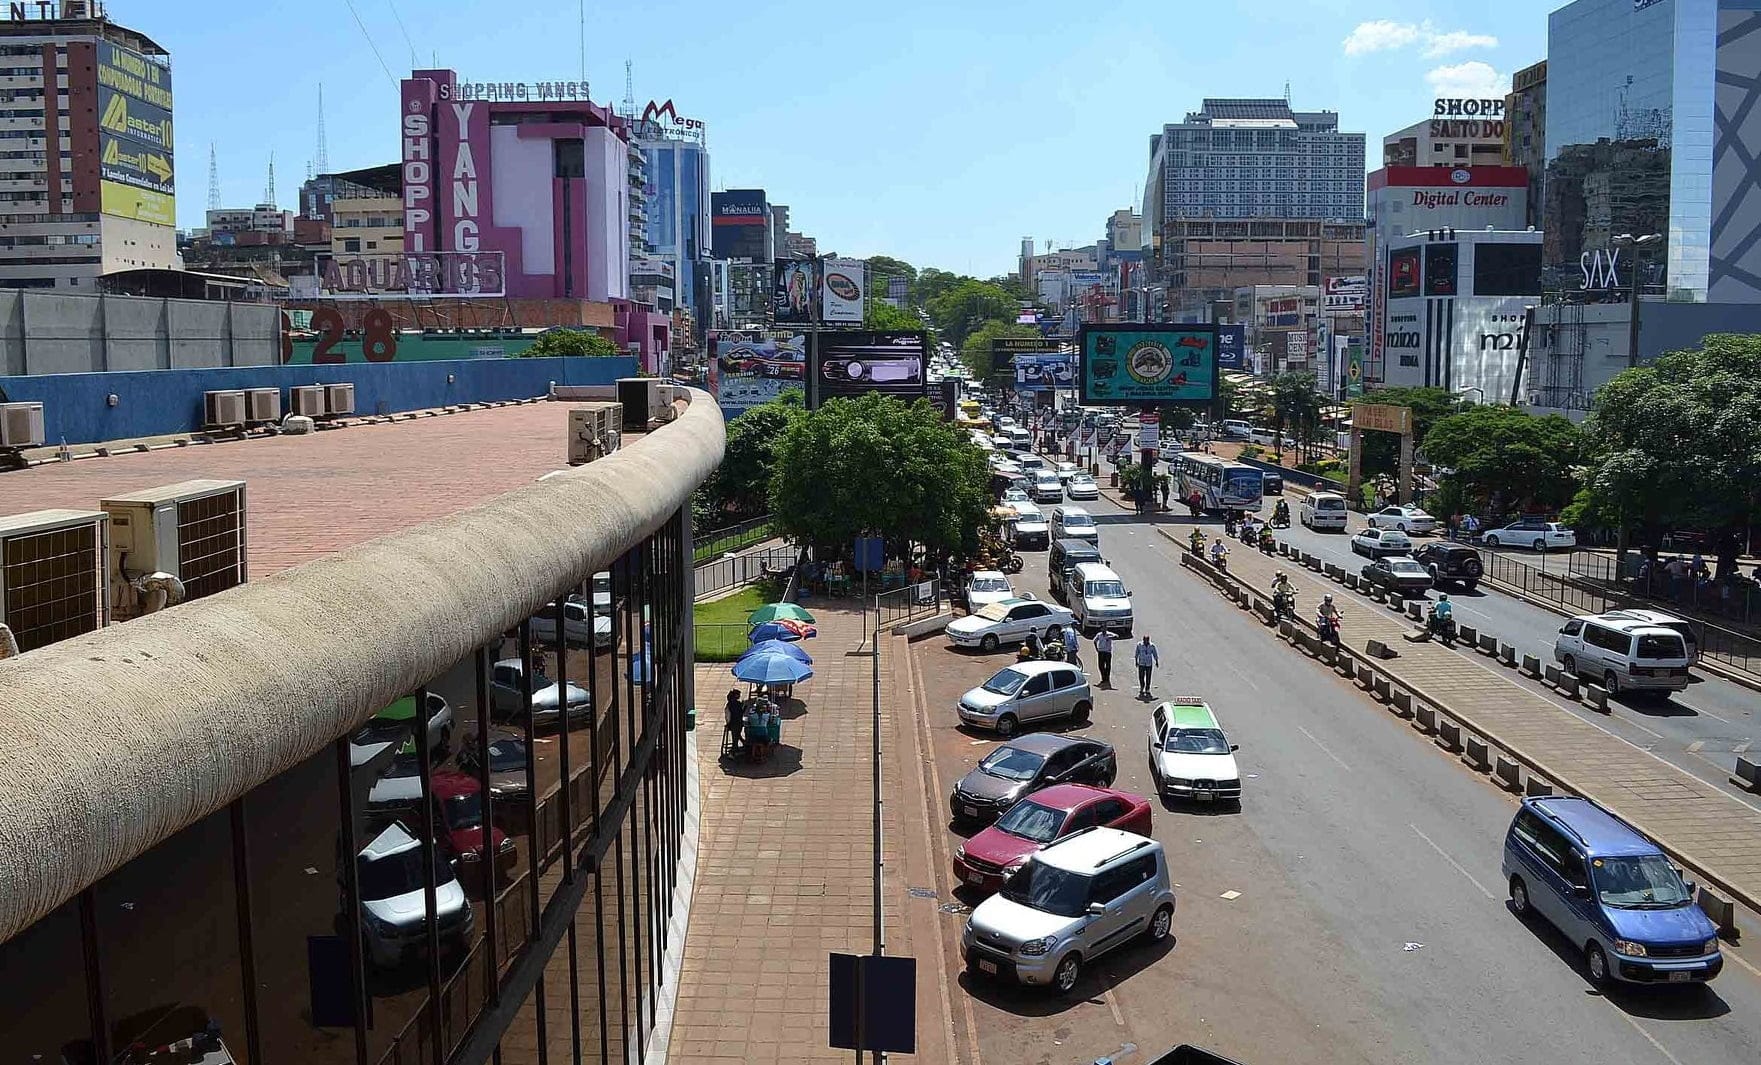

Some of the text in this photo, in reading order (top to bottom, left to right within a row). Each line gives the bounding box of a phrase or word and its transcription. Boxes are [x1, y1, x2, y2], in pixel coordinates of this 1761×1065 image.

[440, 83, 525, 99] SHOPPING
[641, 99, 704, 129] Mega
[1430, 119, 1479, 138] SANTO
[1411, 191, 1508, 209] Digital Center
[1580, 247, 1620, 289] SAX
